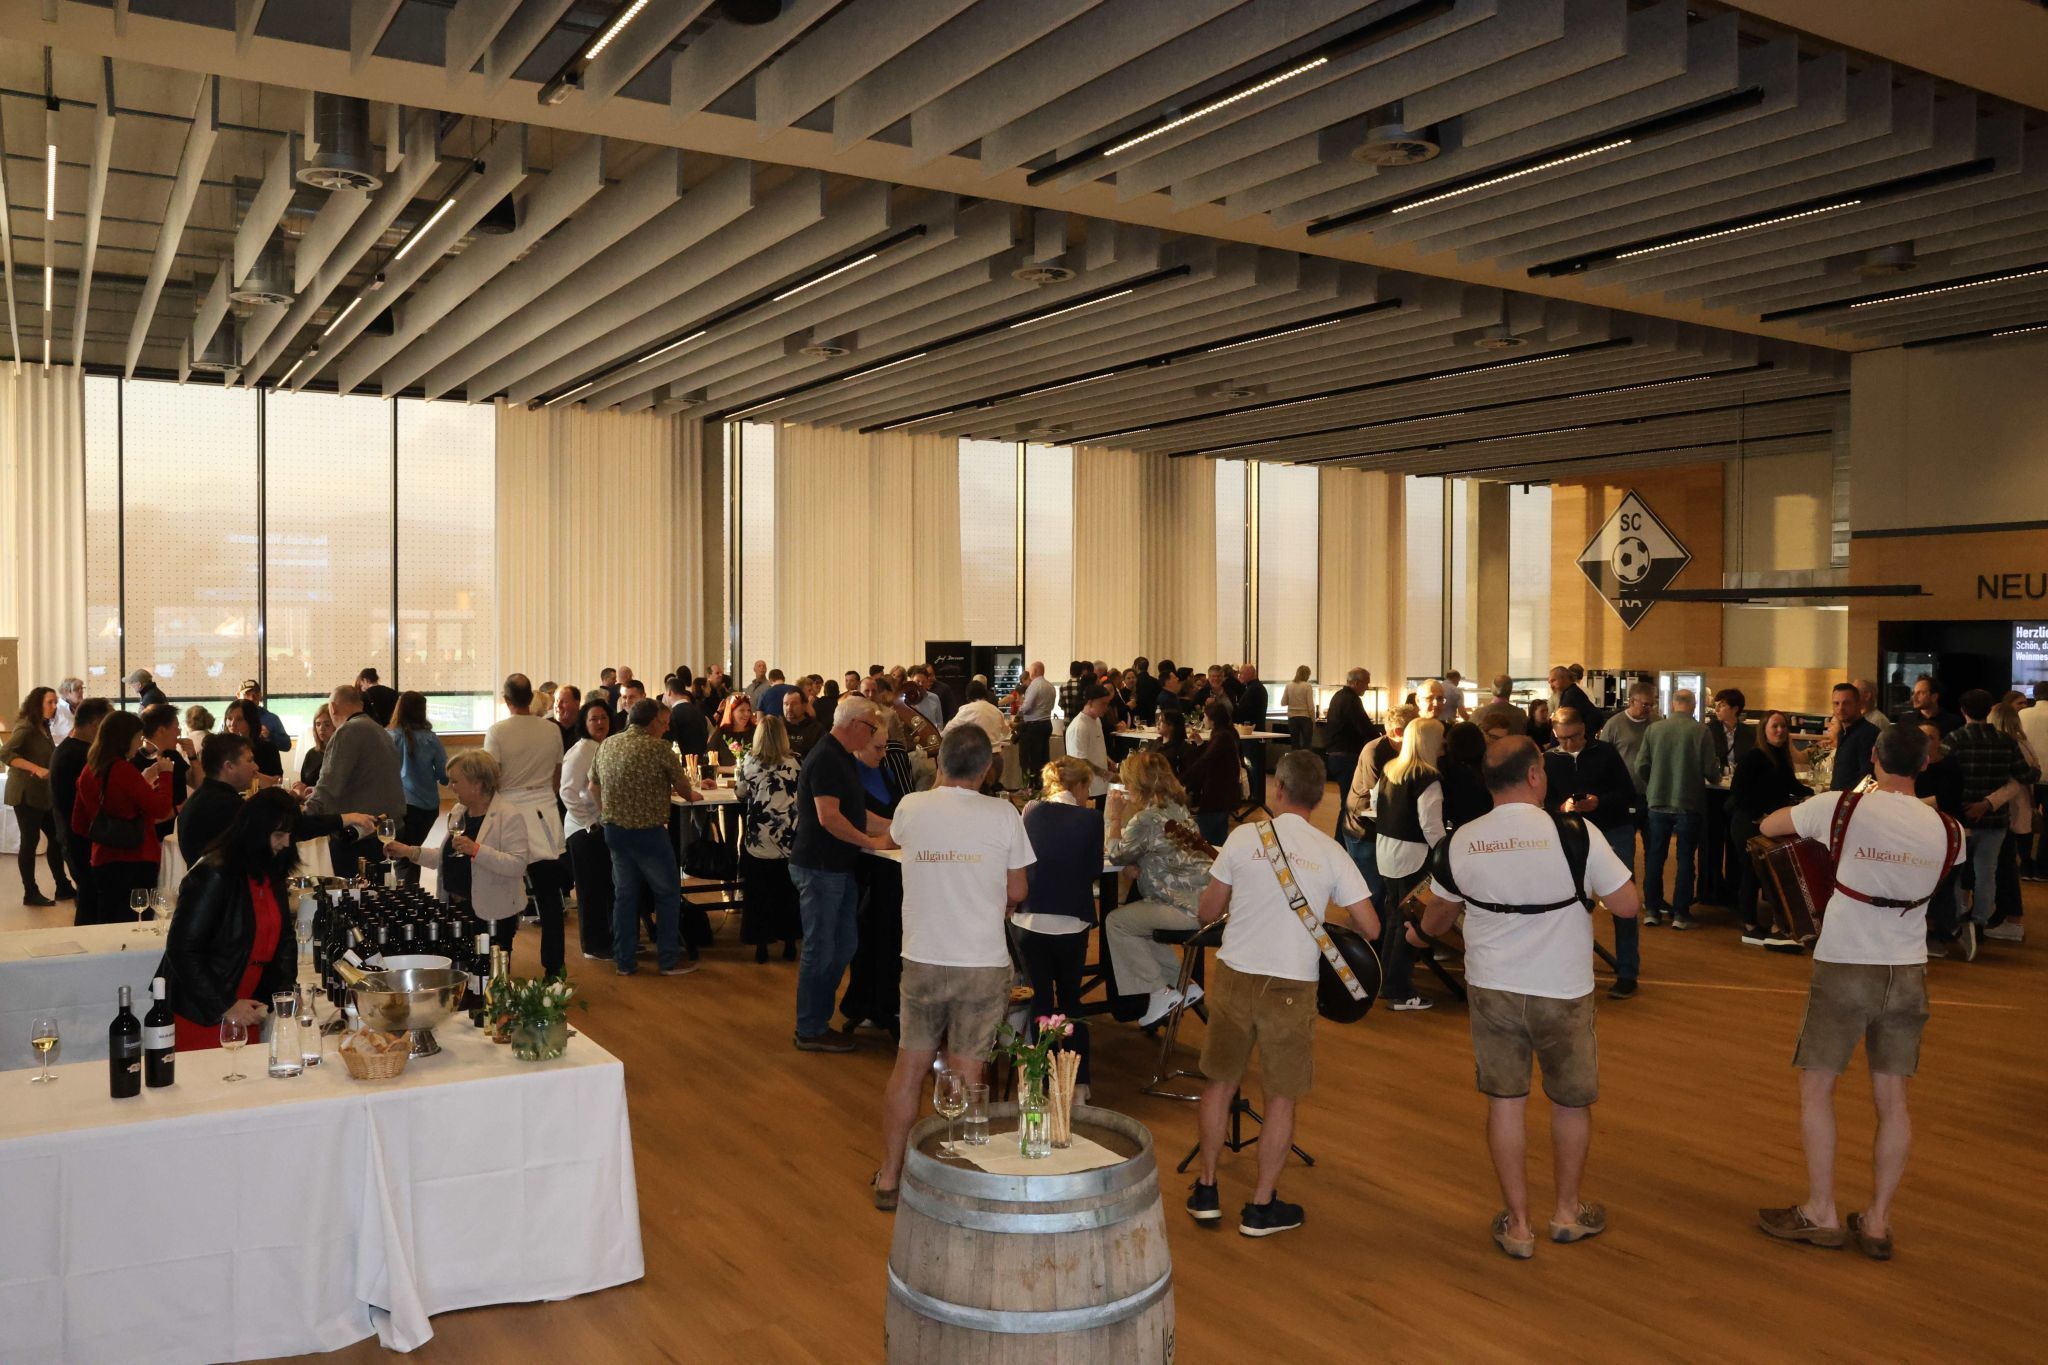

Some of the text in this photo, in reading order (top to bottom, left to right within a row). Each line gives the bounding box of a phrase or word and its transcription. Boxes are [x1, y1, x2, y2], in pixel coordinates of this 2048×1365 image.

[1620, 513, 1642, 532] SC
[1977, 572, 2047, 599] NEU
[2016, 640, 2048, 651] Schön, d
[1467, 837, 1551, 855] AllgäuFeuer
[915, 849, 984, 863] AllgäuFeuer
